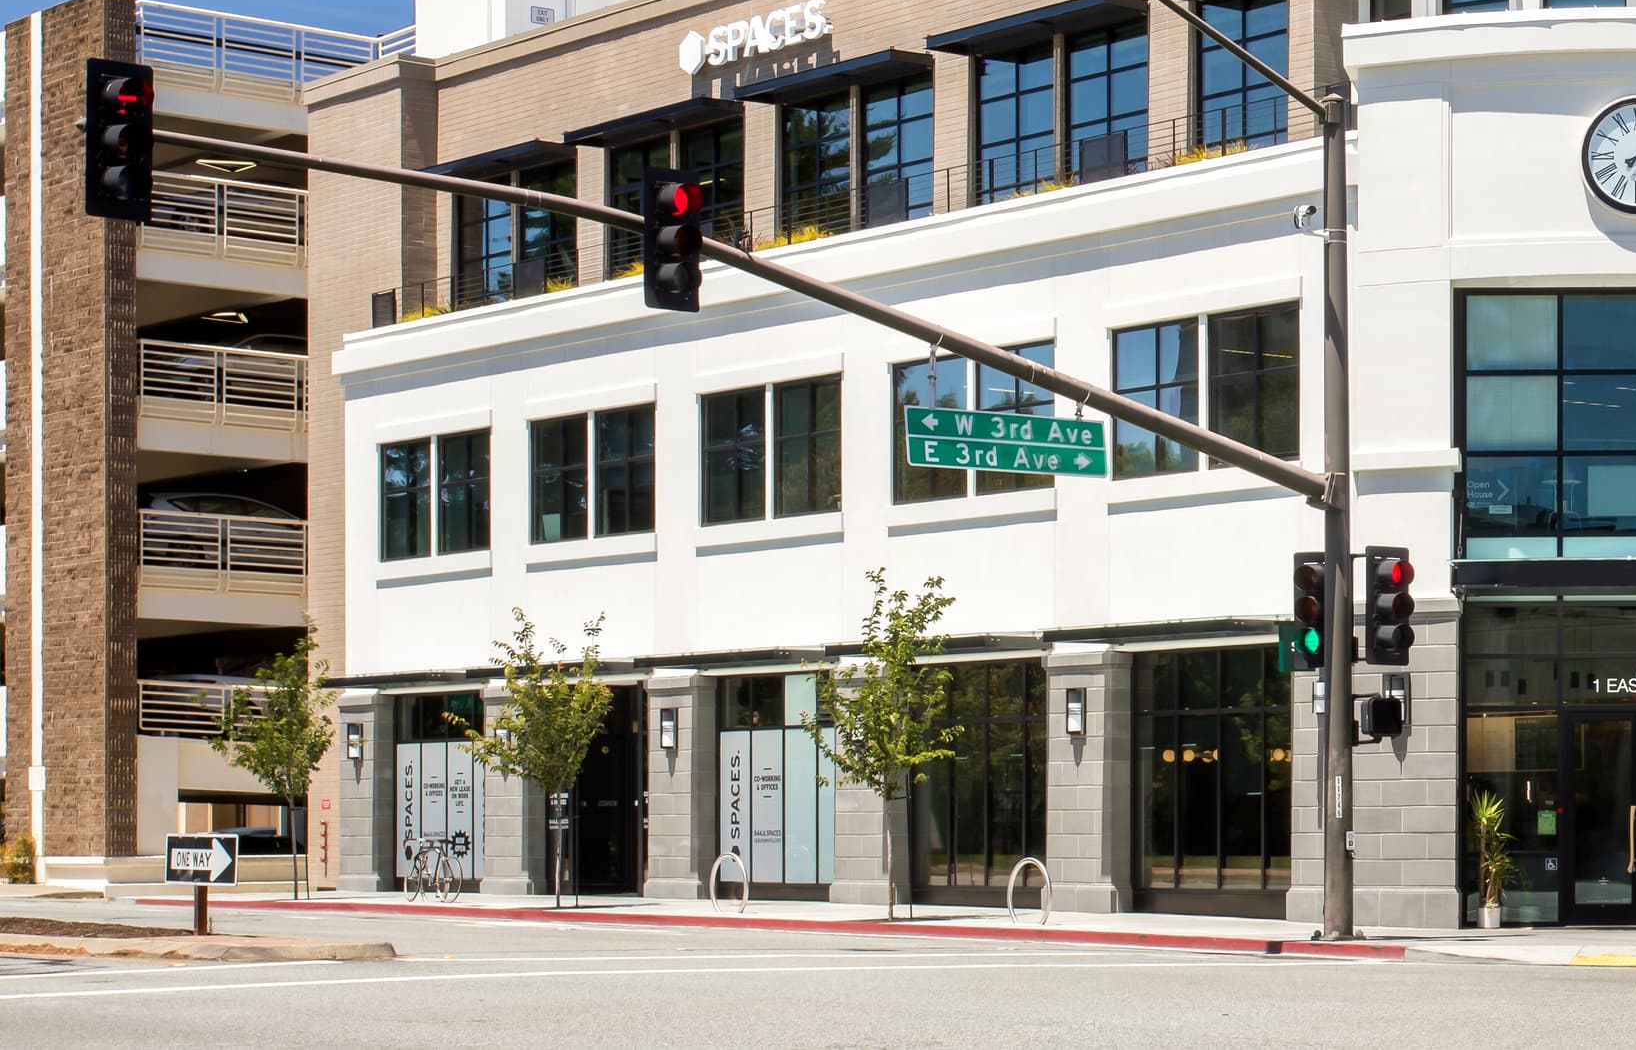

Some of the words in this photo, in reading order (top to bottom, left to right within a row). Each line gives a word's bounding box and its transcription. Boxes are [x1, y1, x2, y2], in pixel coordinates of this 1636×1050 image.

[954, 414, 974, 436] W
[990, 417, 1033, 440] 3rd
[1047, 422, 1093, 445] Ave
[924, 440, 940, 463] E
[956, 443, 998, 466] 3rd
[1013, 448, 1059, 470] Ave
[1467, 480, 1490, 490] Open
[1592, 678, 1600, 693] 1
[176, 852, 190, 866] ONE
[192, 852, 212, 867] WAY
